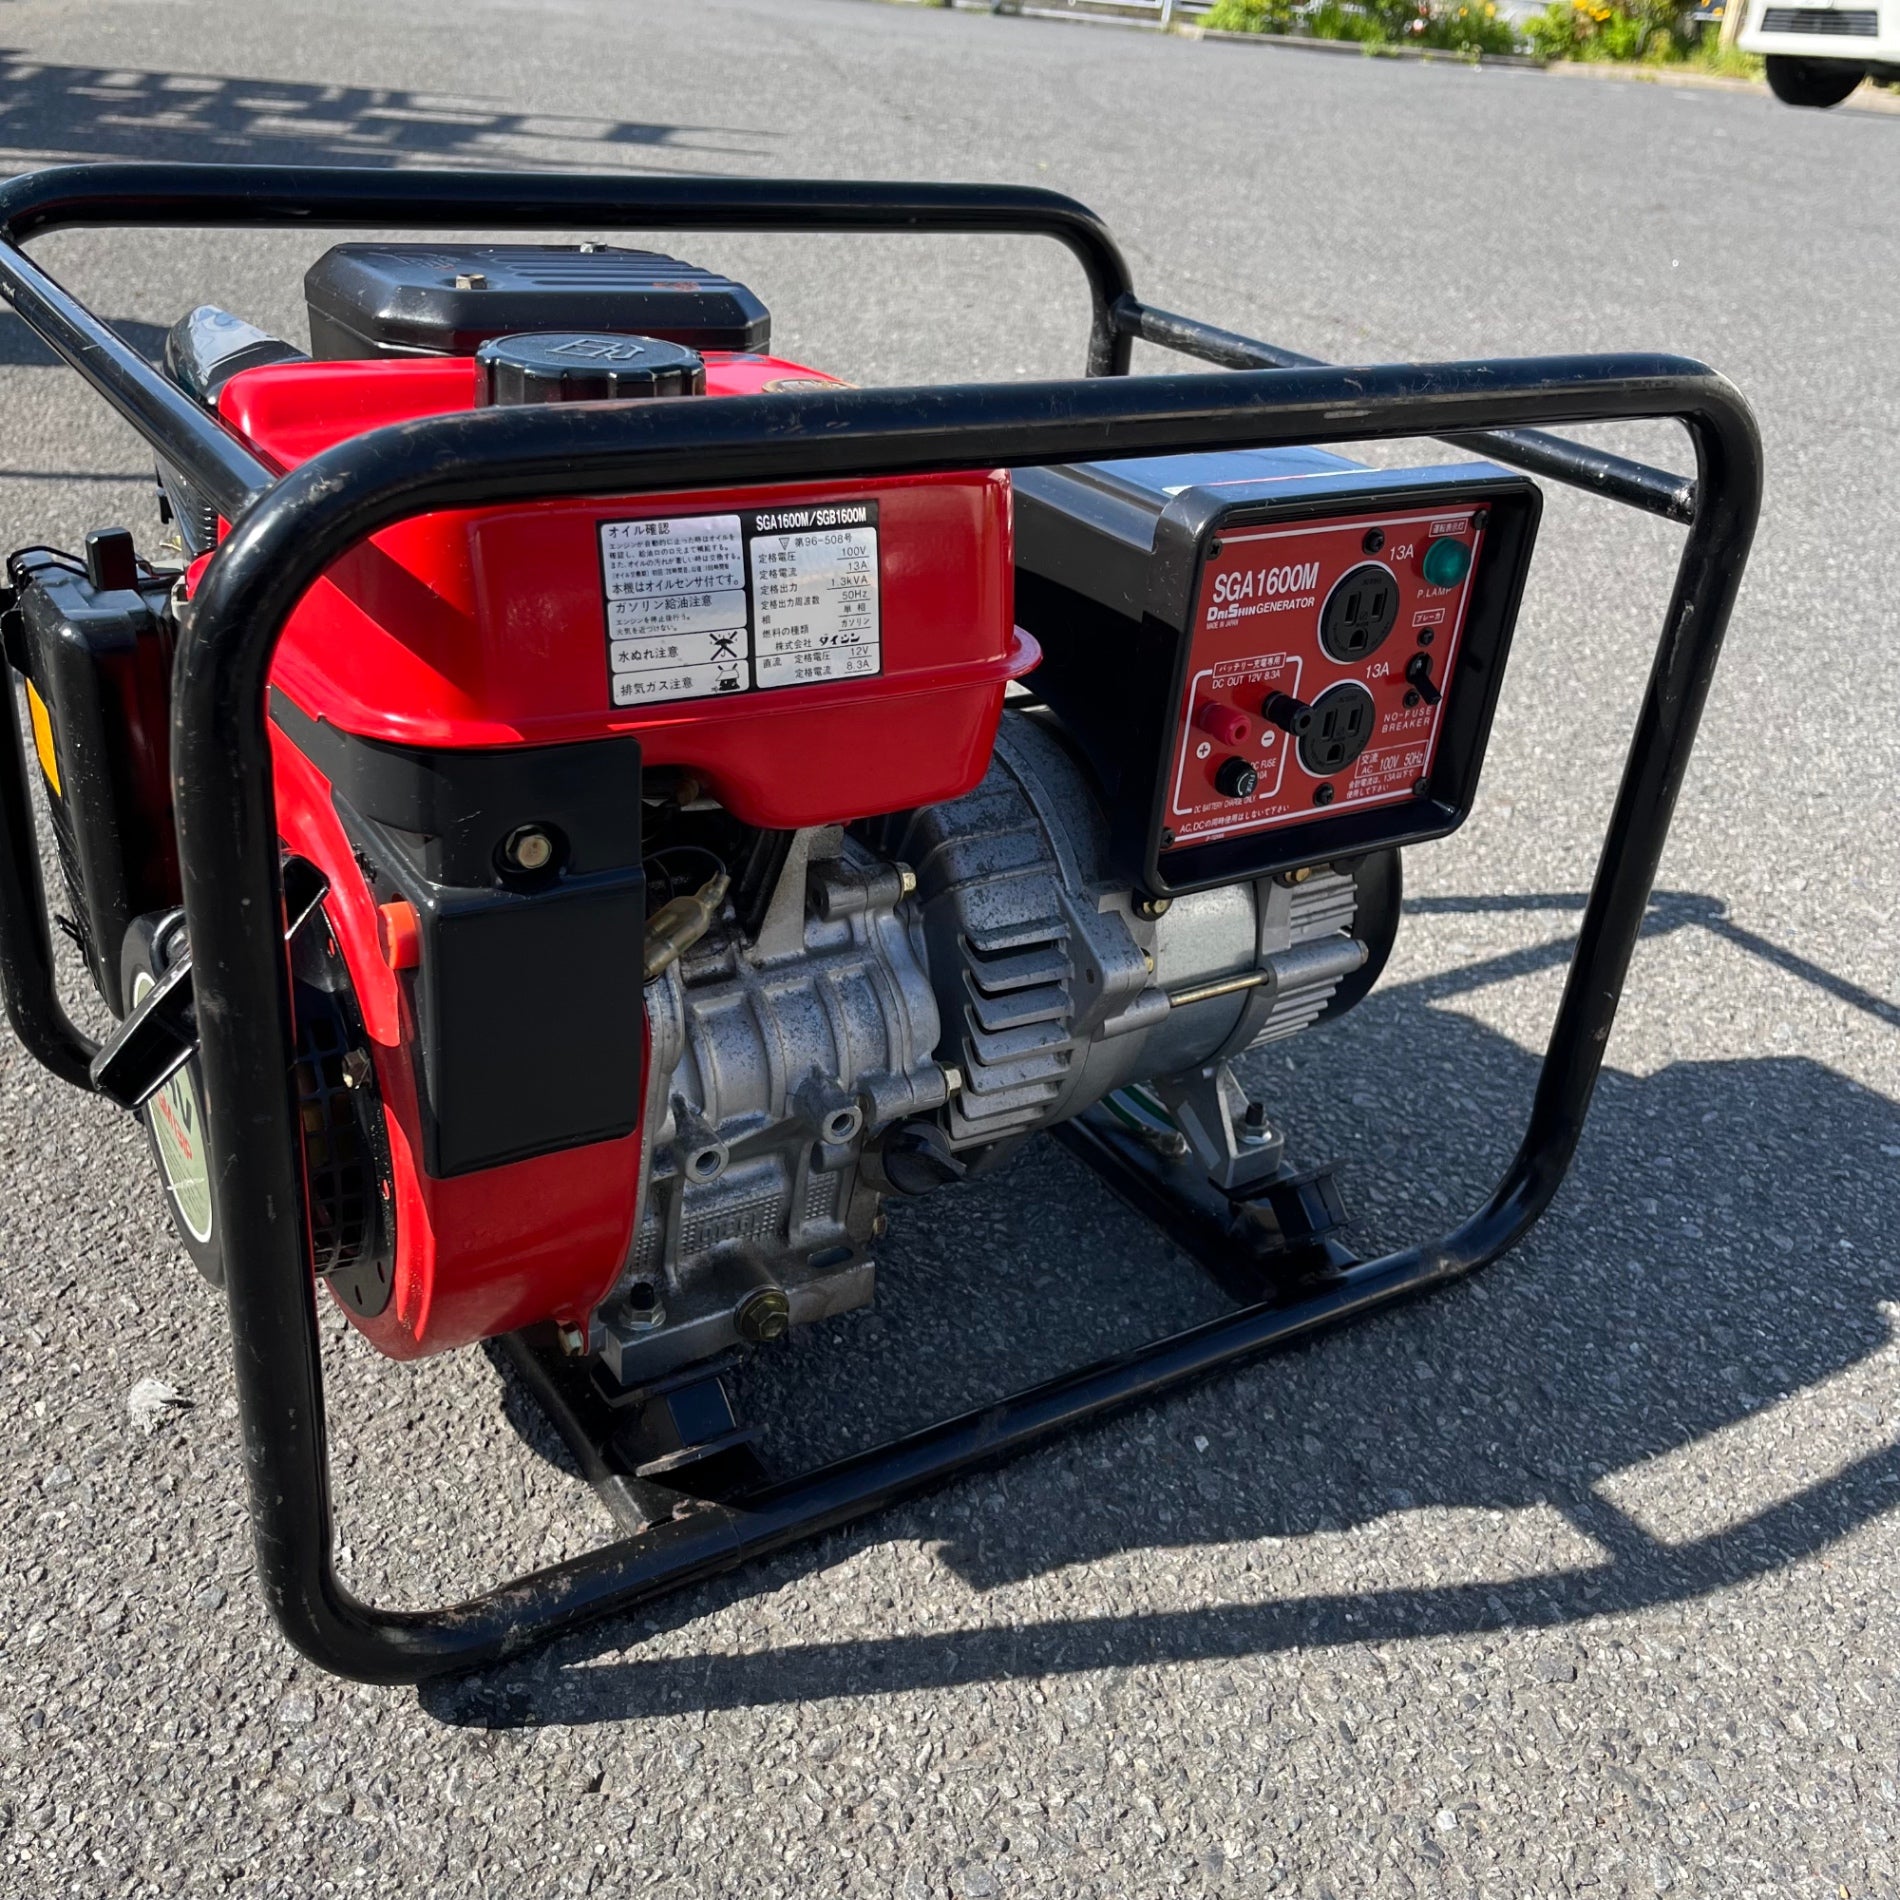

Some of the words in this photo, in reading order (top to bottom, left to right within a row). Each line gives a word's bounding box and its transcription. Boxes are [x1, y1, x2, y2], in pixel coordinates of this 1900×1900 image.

[756, 507, 866, 531] SGA1600M/SGB1600M
[609, 522, 670, 538] オイル確認
[758, 552, 796, 564] 定格電圧
[842, 546, 866, 556] 100V
[1390, 544, 1414, 561] 13A
[760, 568, 797, 580] 定格電流
[848, 561, 868, 571] 13A
[612, 574, 738, 594] 本機はオイルセンサ付です。
[760, 583, 797, 595] 定格出力
[1212, 562, 1320, 603] SGA1600M
[761, 596, 820, 610] 定格出力周波数
[842, 590, 867, 600] 50Hz
[616, 594, 712, 614] ガソリン給油注意
[1256, 597, 1315, 614] GENERATOR
[762, 615, 770, 624] 相
[842, 618, 870, 628] ガソリン
[762, 625, 808, 638] 燃料の種類
[776, 639, 812, 651] 株式会社
[820, 633, 860, 646] ダイシン
[618, 646, 678, 663] 水ぬれ注意
[763, 658, 782, 668] 直流
[795, 652, 831, 663] 定格電圧
[850, 646, 869, 656] 12V
[795, 666, 832, 678] 定格電流
[847, 660, 870, 670] 8.3A
[1366, 662, 1389, 679] 13A
[621, 676, 694, 696] 排気ガス注意
[1212, 679, 1224, 689] DC
[1227, 676, 1244, 686] OUT
[1248, 673, 1262, 683] 12V
[1264, 670, 1280, 680] 8.3A
[1384, 706, 1432, 722] NO-FUSE
[1382, 717, 1430, 734] BREAKER
[1261, 758, 1276, 769] FUSE
[1362, 765, 1373, 774] AC
[1380, 754, 1400, 771] 100V
[1404, 751, 1423, 766] 50Hz
